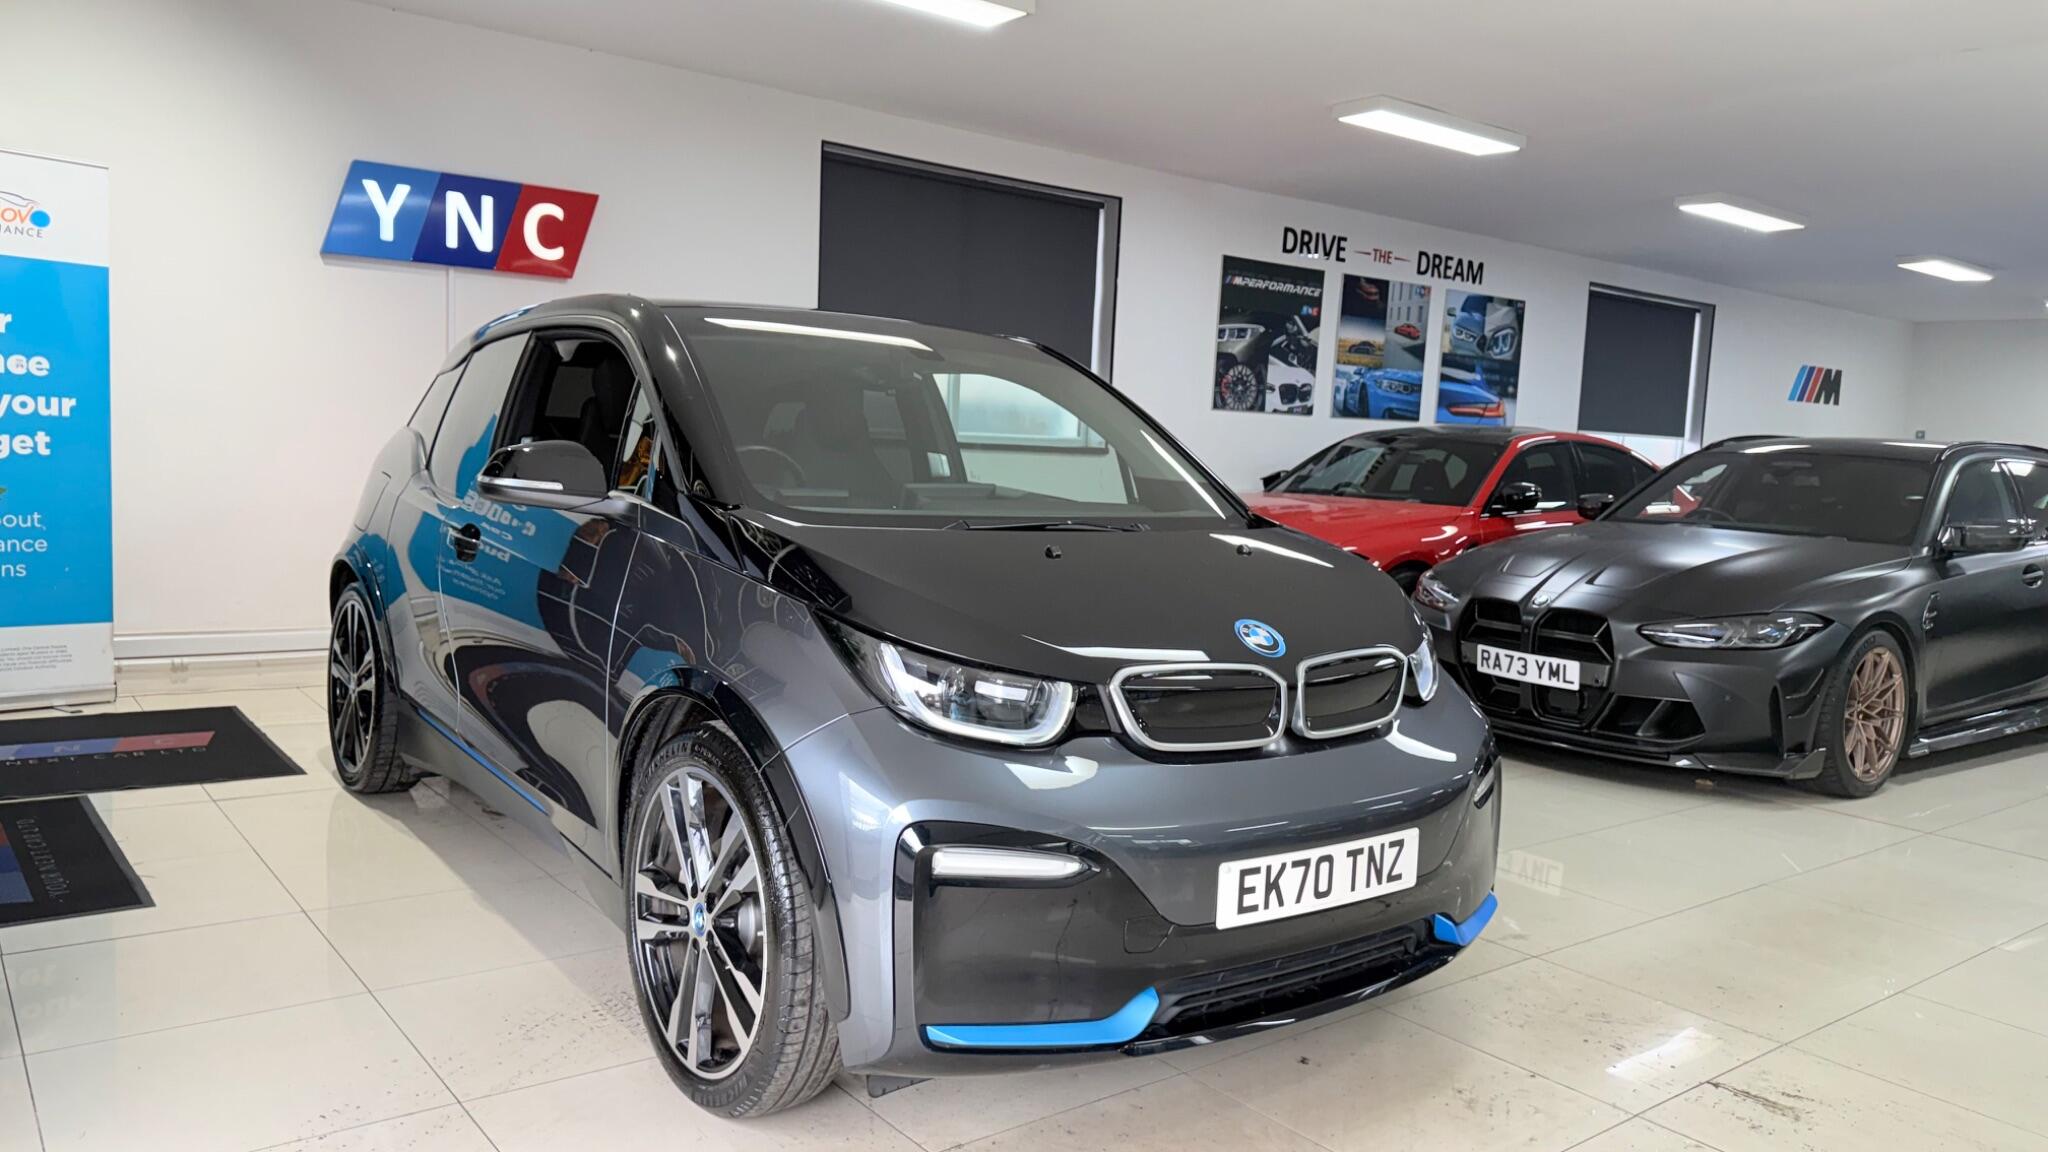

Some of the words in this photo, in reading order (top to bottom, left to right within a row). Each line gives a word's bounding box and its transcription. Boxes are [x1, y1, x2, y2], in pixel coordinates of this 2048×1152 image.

[0, 224, 43, 238] ANCE
[362, 178, 565, 261] YNC
[1282, 226, 1347, 263] DRIVE
[1372, 248, 1393, 264] THE
[1416, 251, 1484, 285] DREAM
[0, 512, 46, 531] out,
[1480, 649, 1528, 676] RA73
[1535, 659, 1575, 685] YML
[1236, 854, 1335, 916] EK70
[1346, 838, 1405, 893] TNZ
